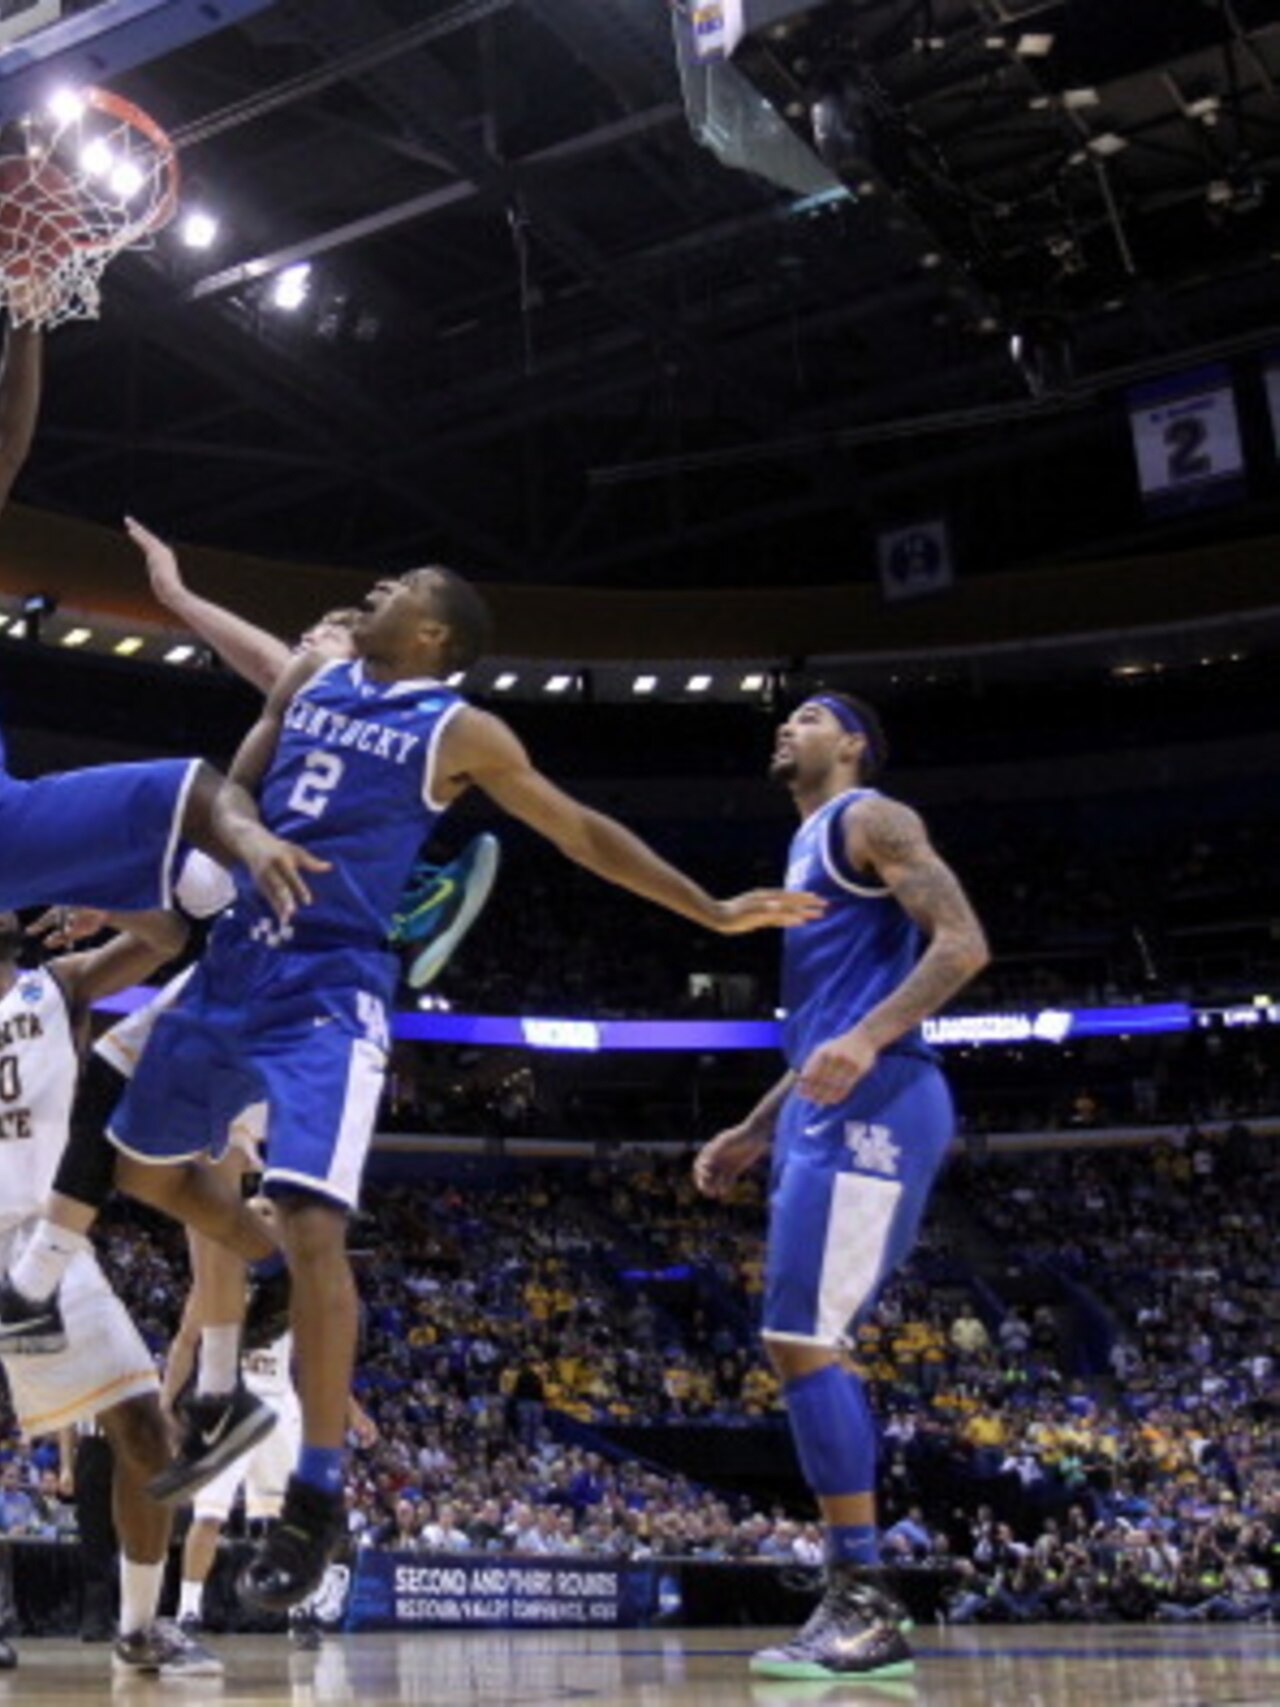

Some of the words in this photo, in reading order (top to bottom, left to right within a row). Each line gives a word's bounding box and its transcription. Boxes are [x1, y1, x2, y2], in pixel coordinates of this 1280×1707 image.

[1163, 417, 1212, 479] 2
[287, 749, 345, 821] 2
[395, 1564, 466, 1596] SECOND
